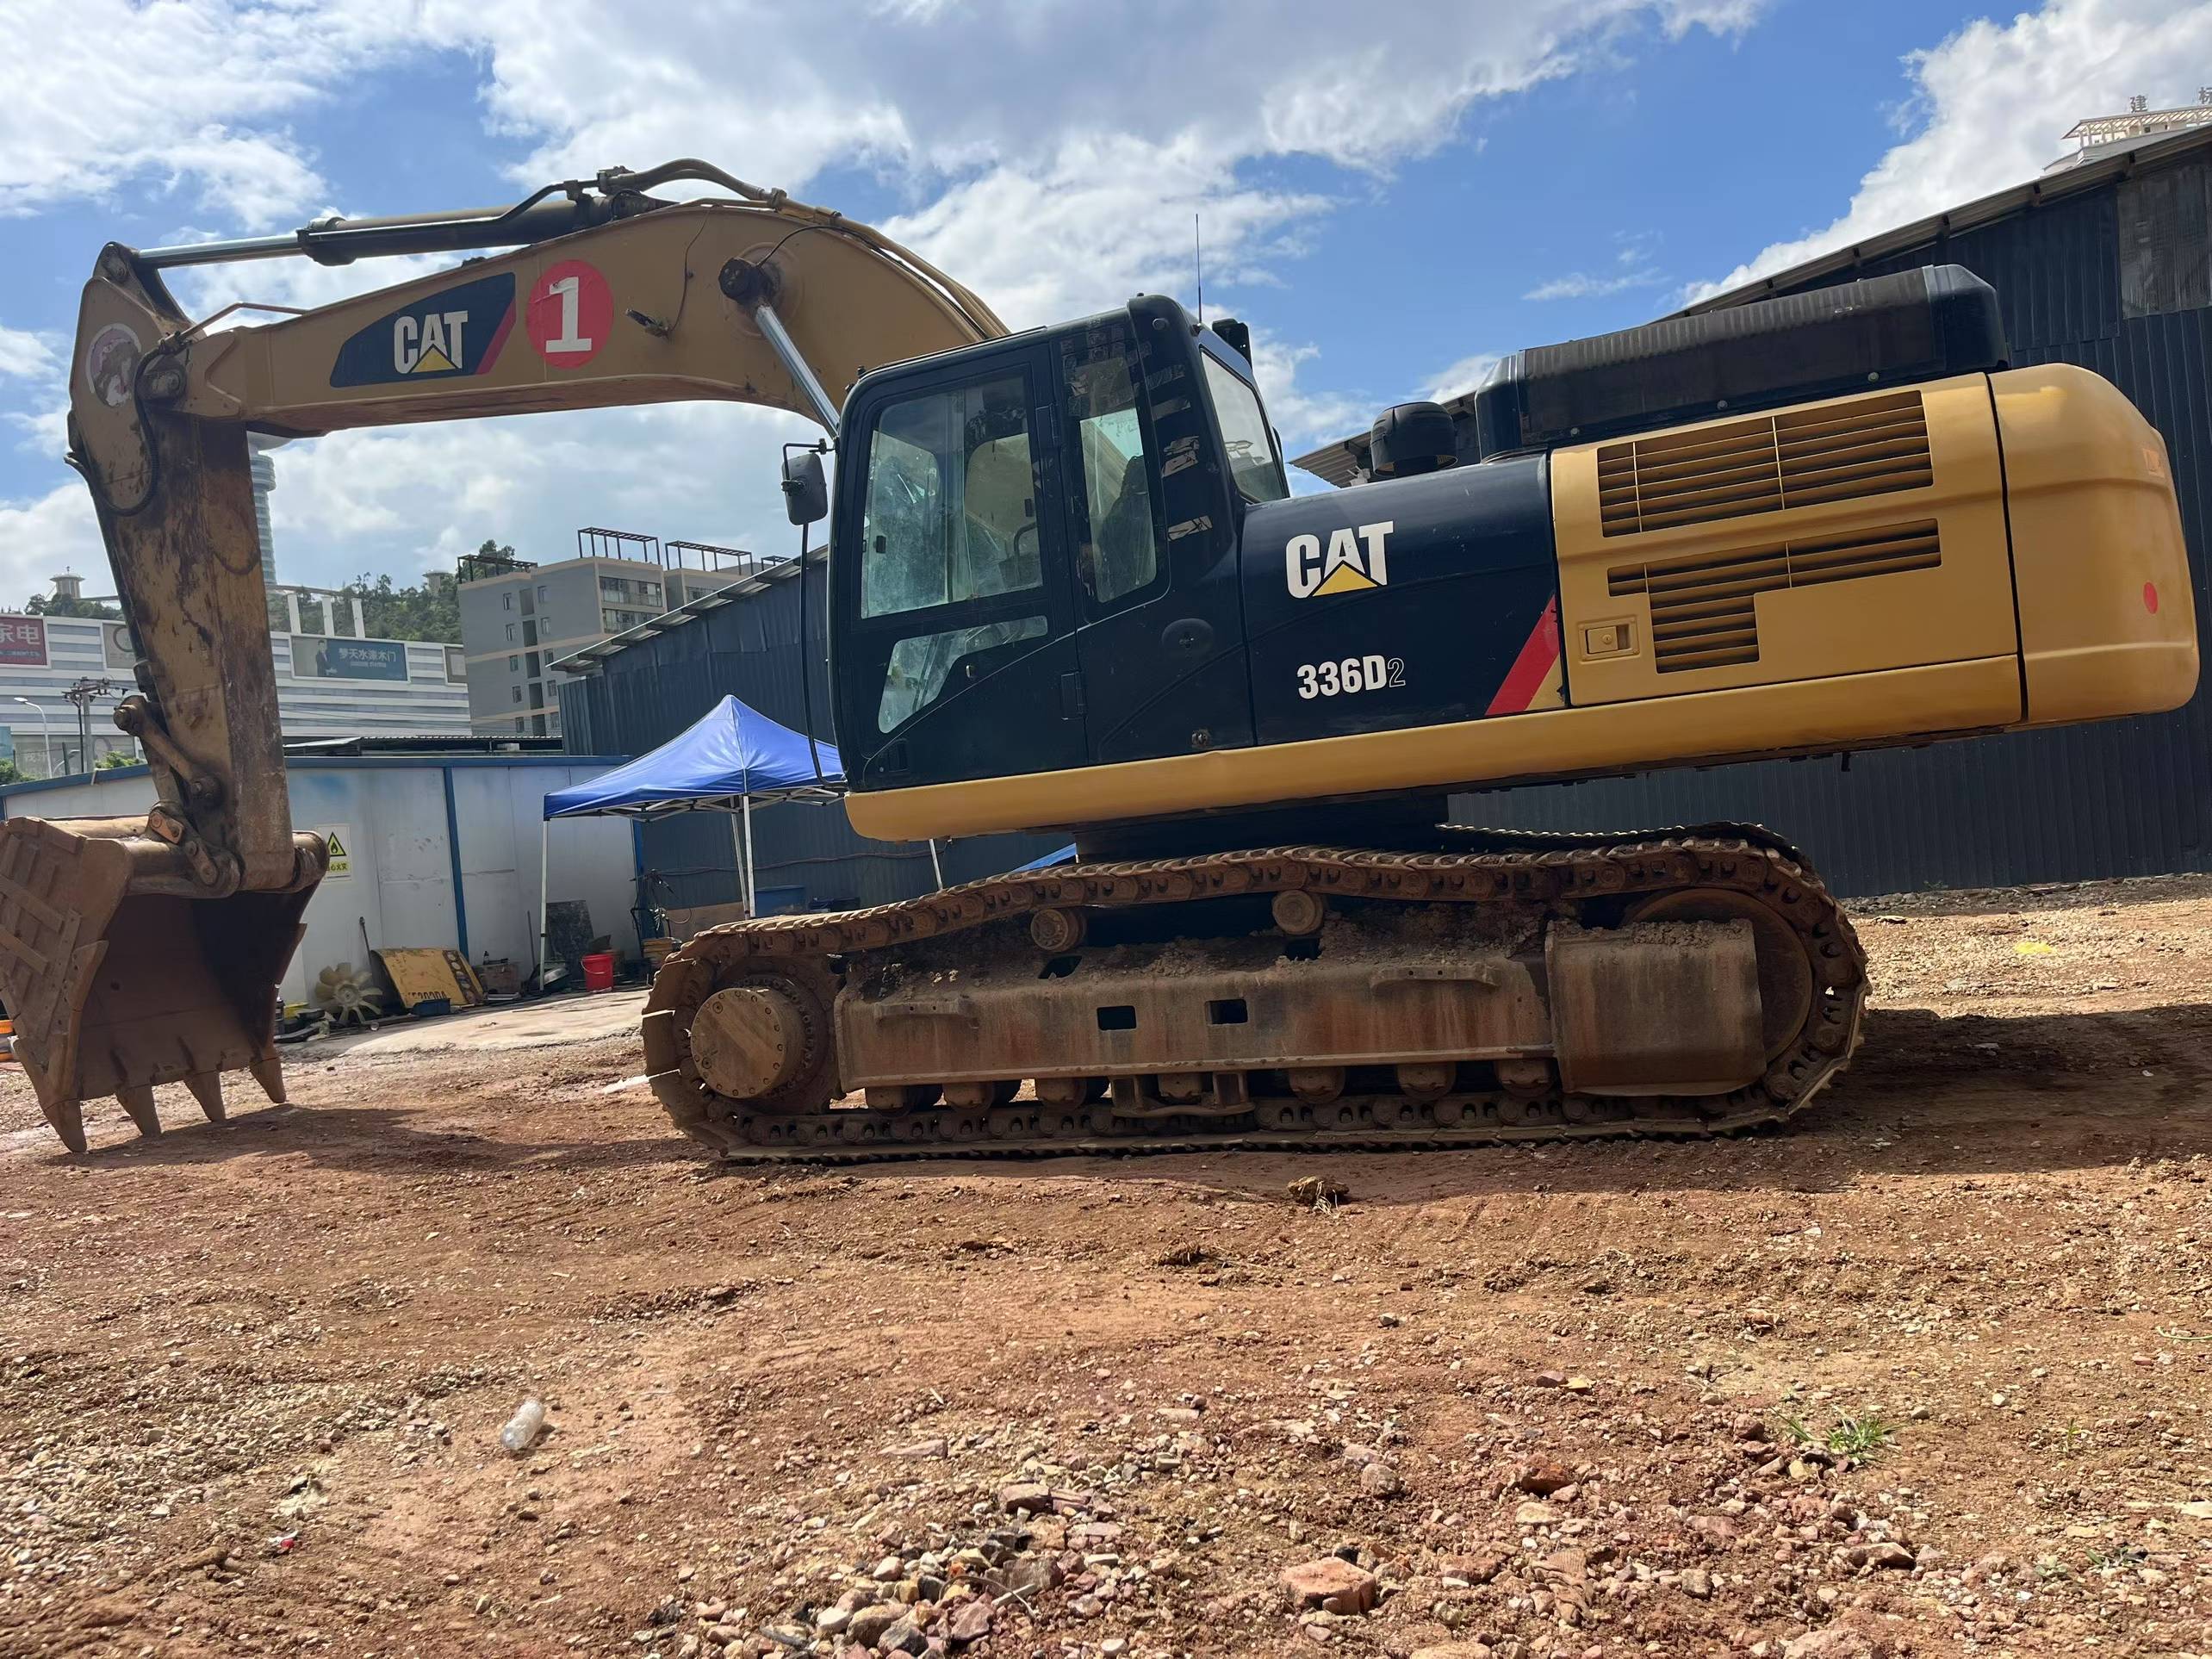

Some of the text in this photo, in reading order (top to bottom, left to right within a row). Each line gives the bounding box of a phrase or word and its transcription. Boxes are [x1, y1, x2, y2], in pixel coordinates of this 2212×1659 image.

[394, 310, 469, 374] CAT
[545, 276, 593, 353] 1
[1285, 520, 1394, 599] CAT
[1296, 655, 1407, 700] 336D2
[330, 862, 348, 872] 心火灾
